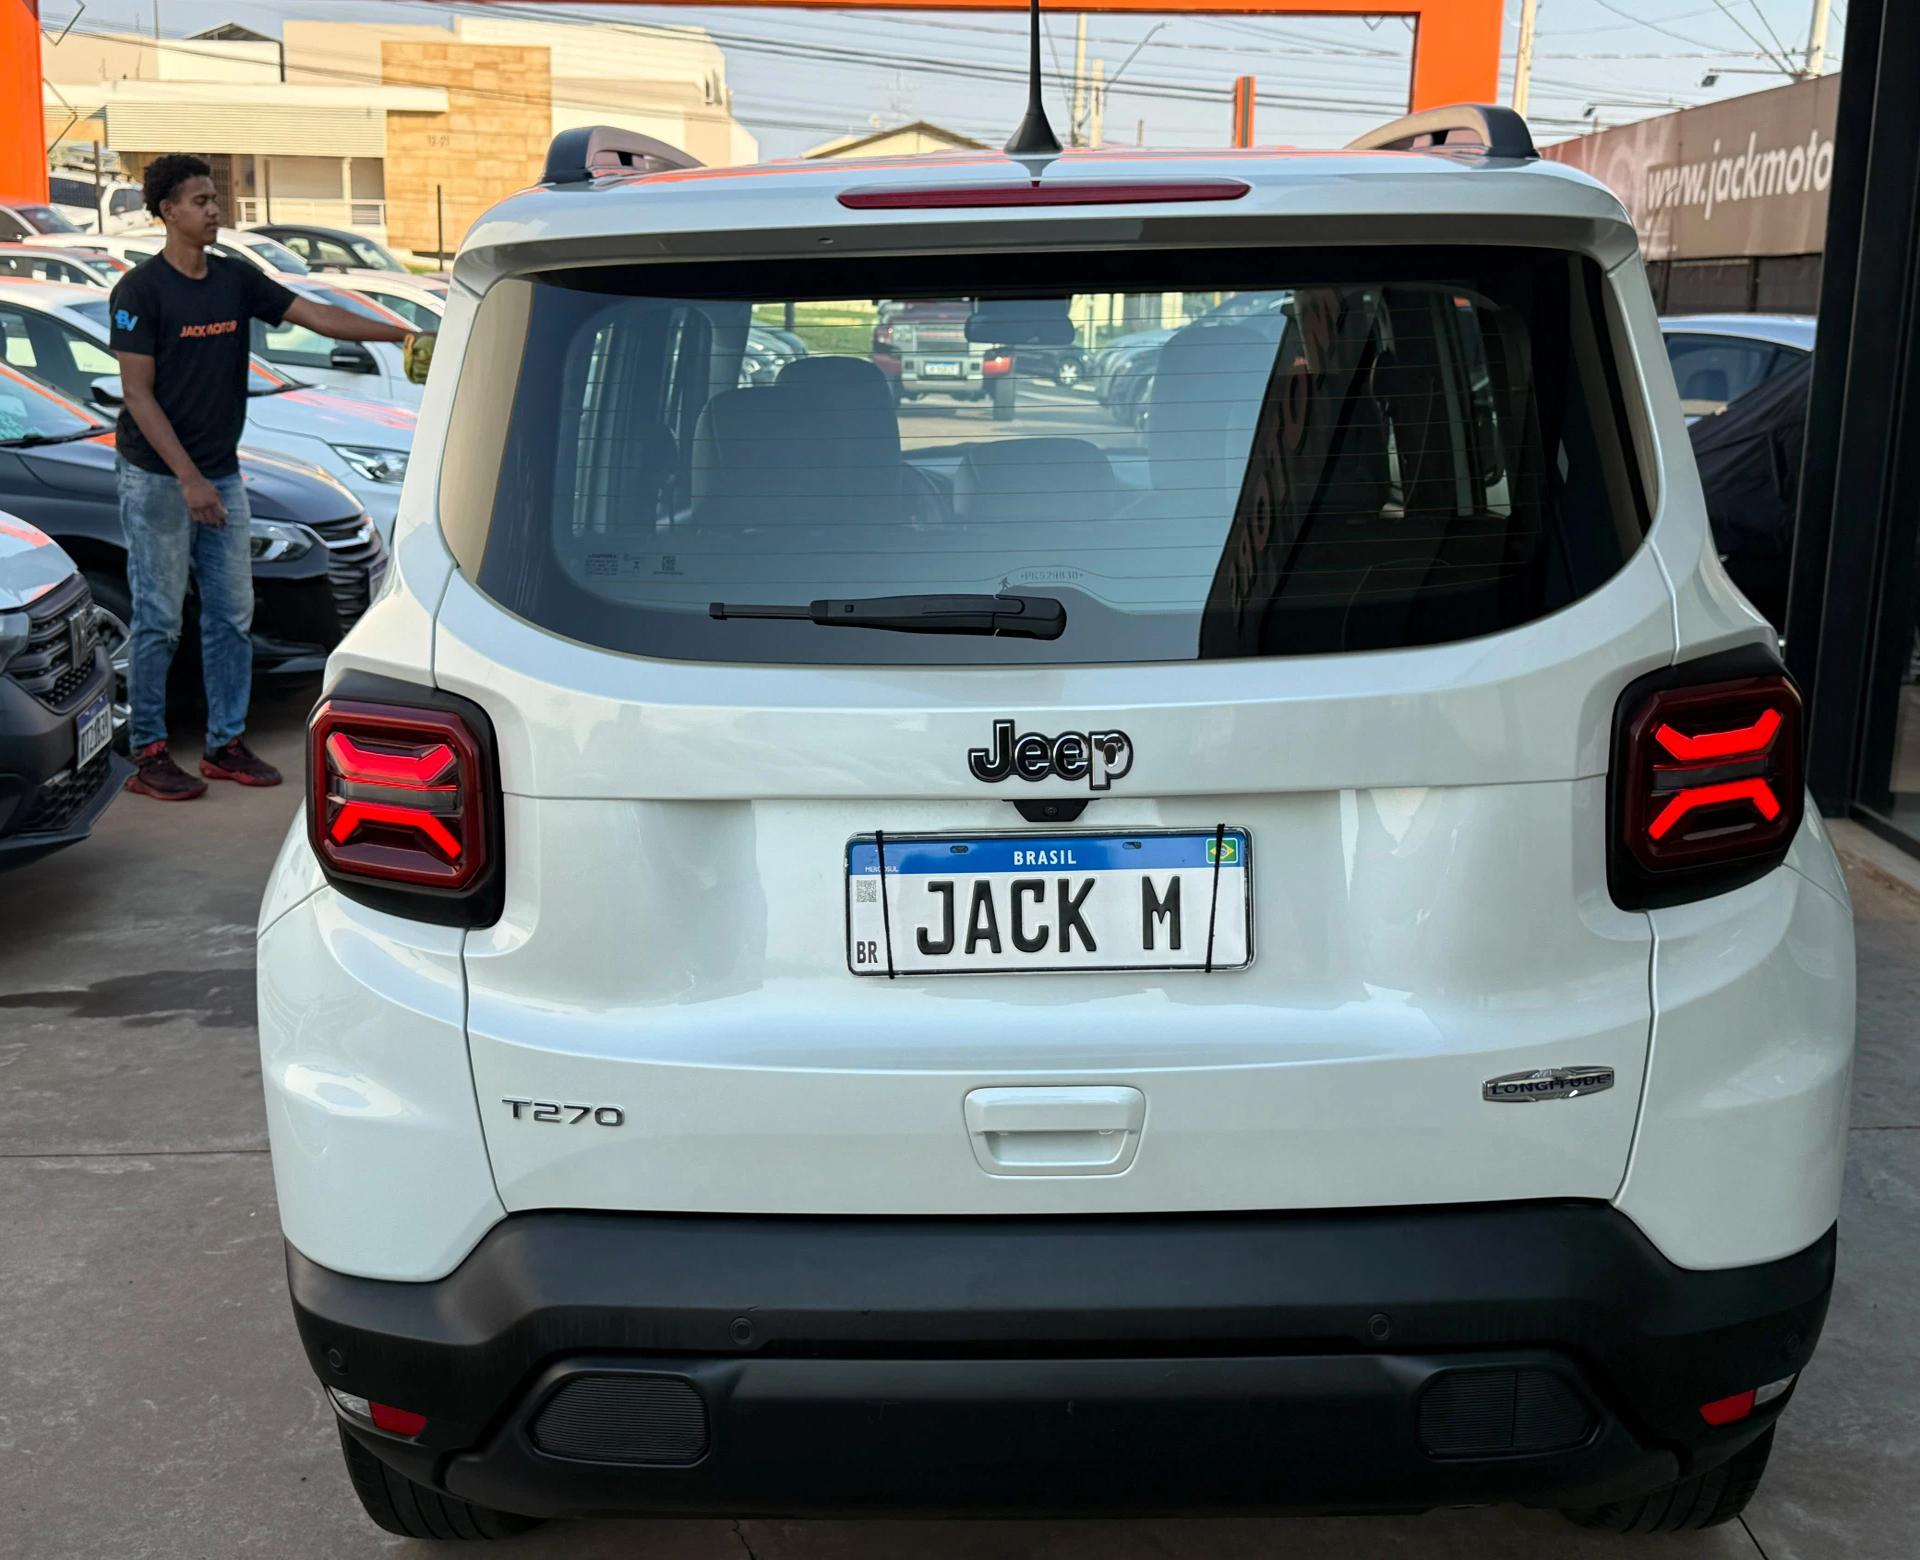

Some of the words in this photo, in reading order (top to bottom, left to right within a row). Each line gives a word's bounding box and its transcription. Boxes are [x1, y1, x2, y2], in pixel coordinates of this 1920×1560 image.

[180, 325, 206, 338] JACK
[968, 719, 1133, 790] Jeep
[1013, 849, 1077, 866] BRASIL
[916, 877, 1097, 955] JACK
[1141, 875, 1182, 950] M
[856, 941, 879, 964] BR
[1490, 1073, 1613, 1096] LONGITUDE
[501, 1096, 625, 1127] T270
